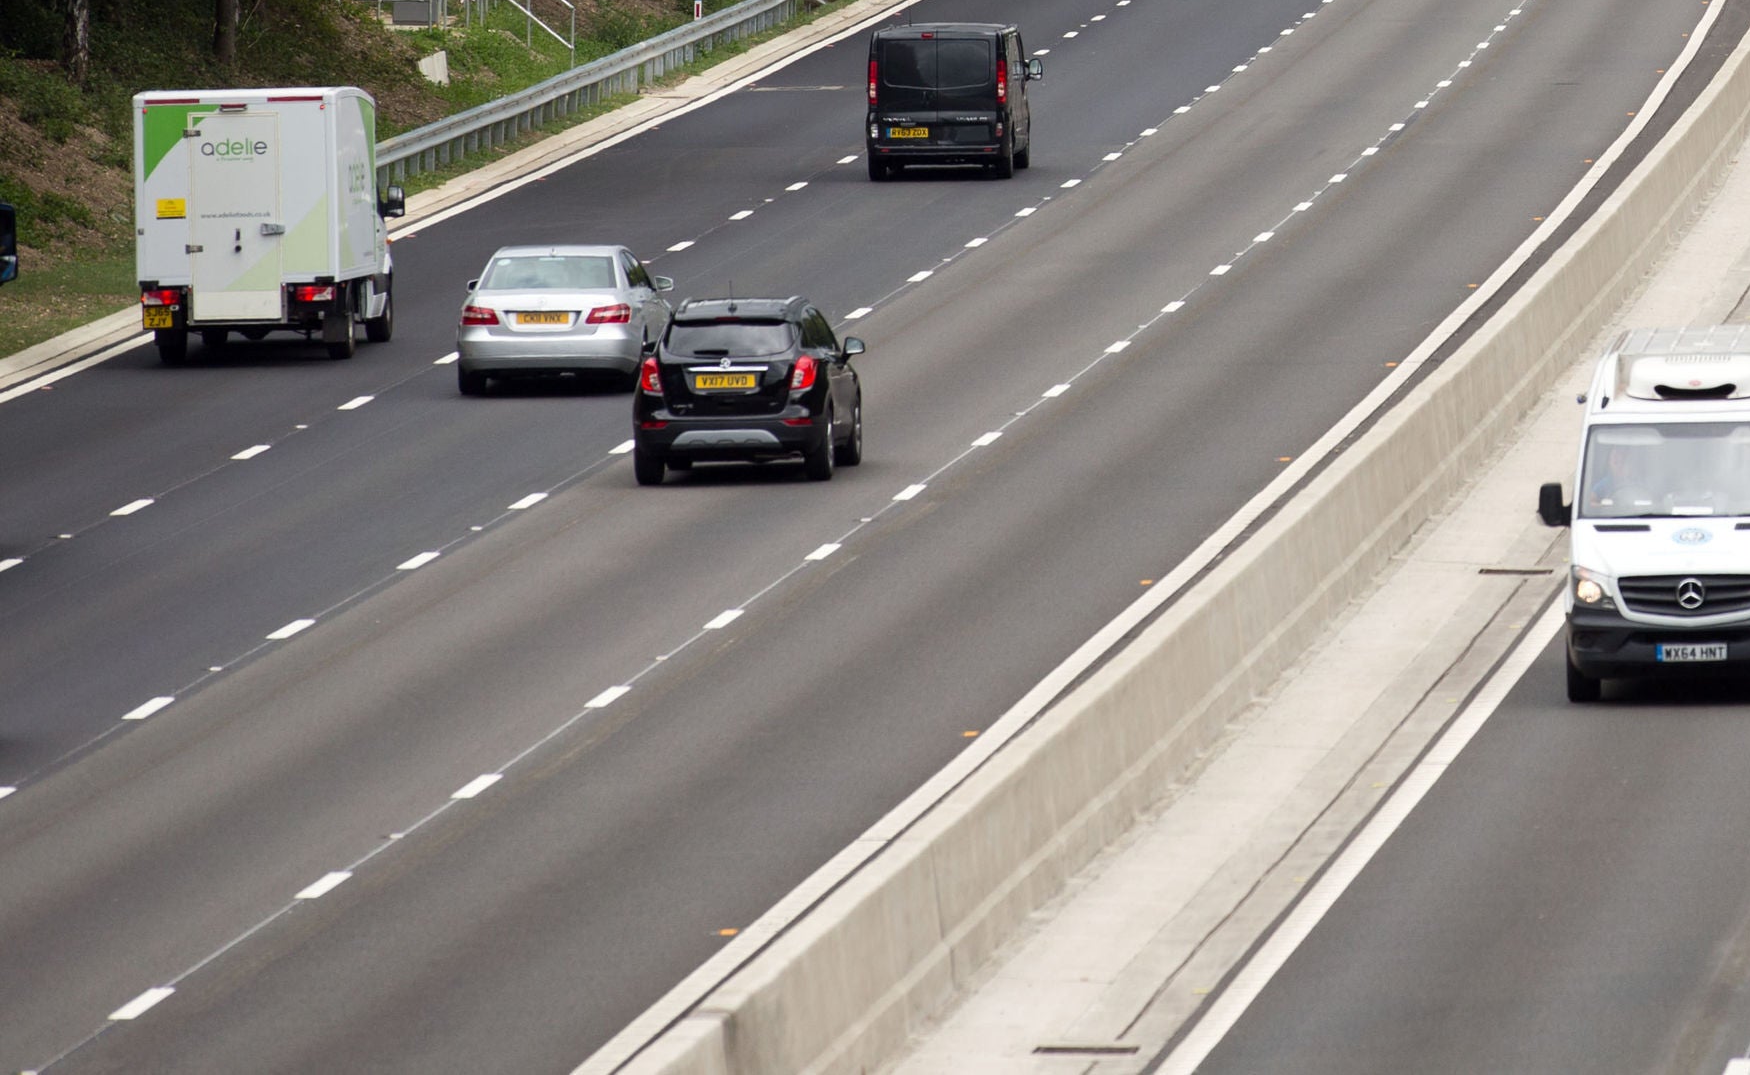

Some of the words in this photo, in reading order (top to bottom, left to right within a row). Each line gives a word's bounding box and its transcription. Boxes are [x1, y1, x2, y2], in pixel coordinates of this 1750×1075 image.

[201, 137, 268, 156] adelie
[702, 376, 724, 386] VX17
[727, 376, 748, 385] UVD
[1664, 647, 1697, 659] WX64
[1700, 646, 1725, 658] HNT
